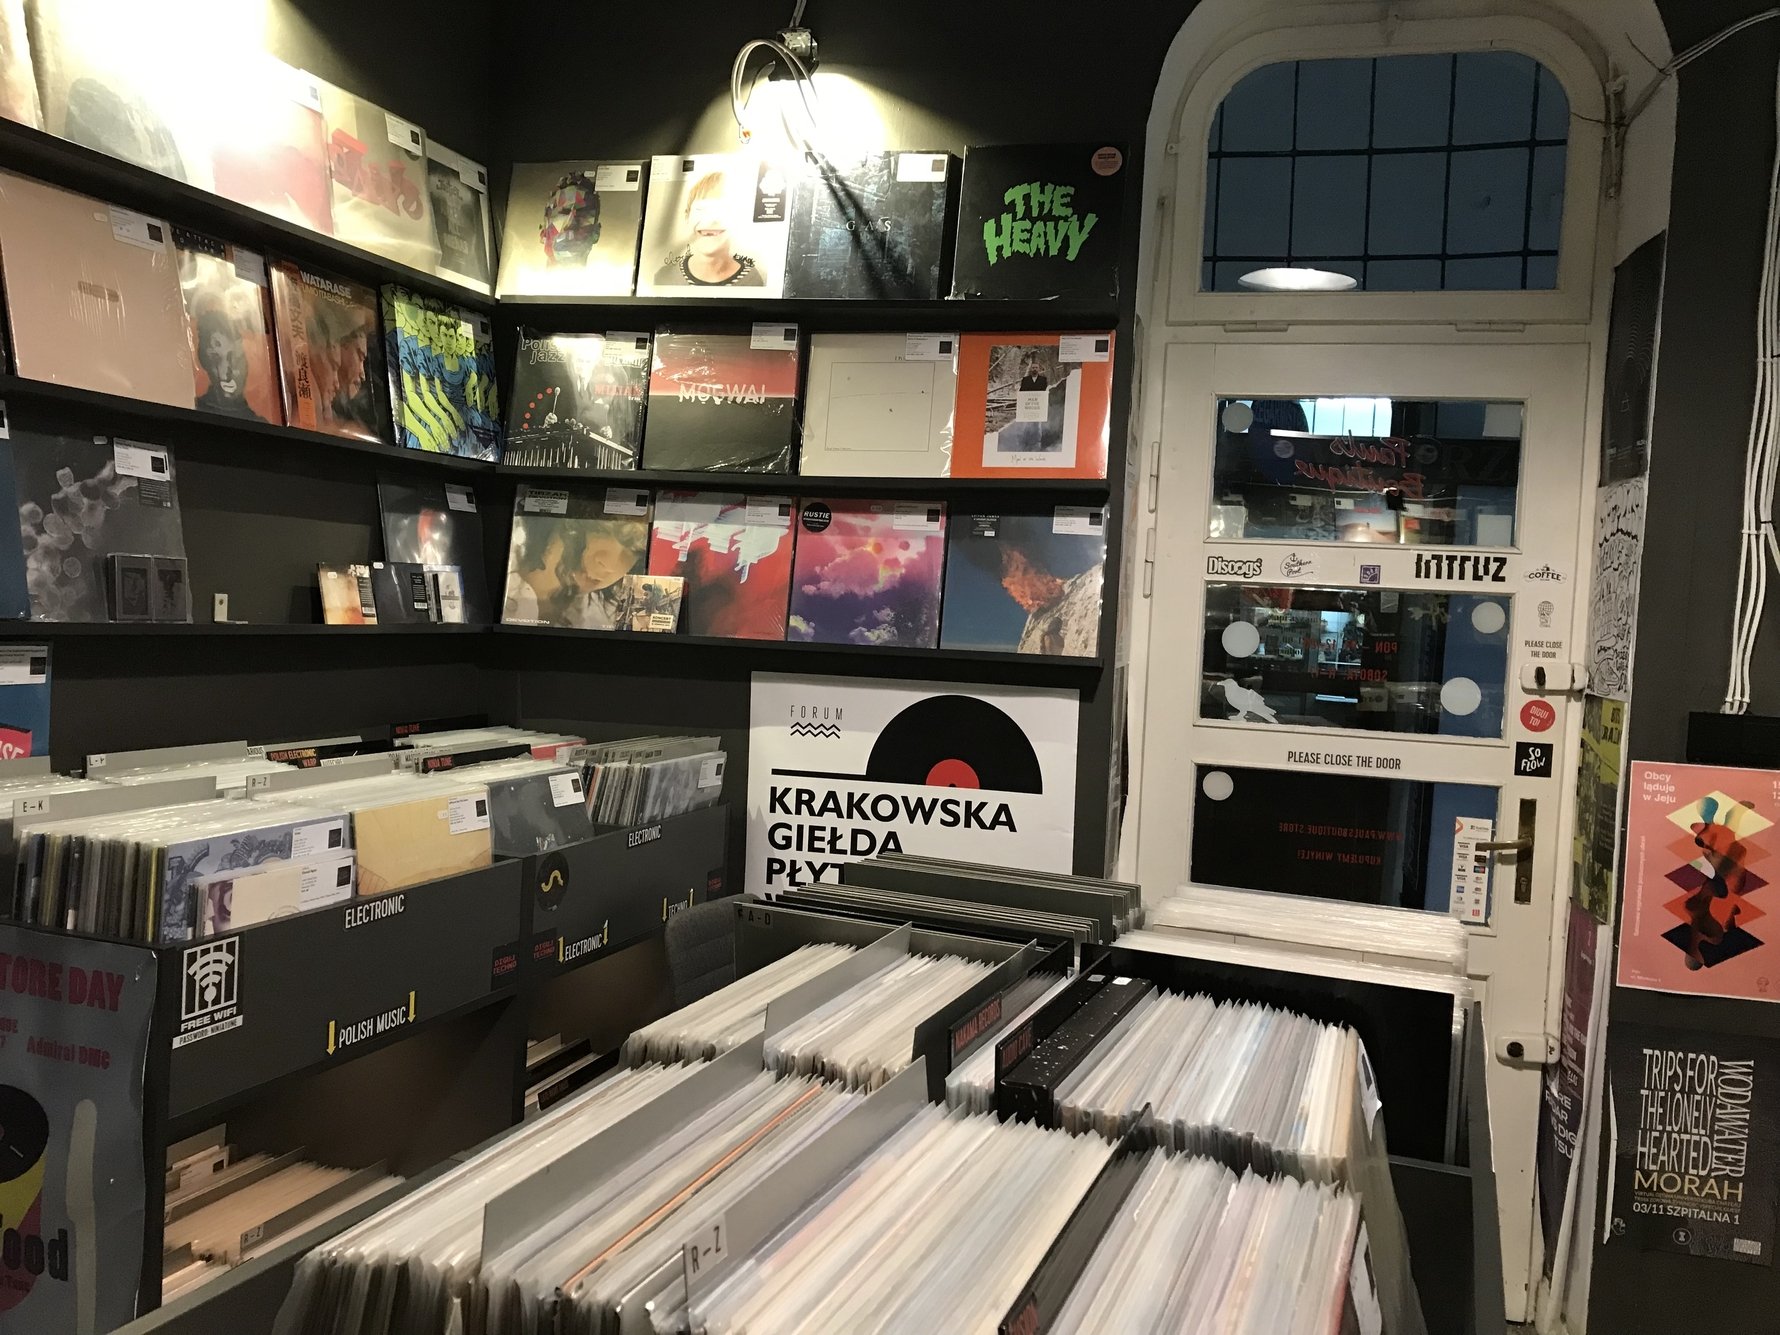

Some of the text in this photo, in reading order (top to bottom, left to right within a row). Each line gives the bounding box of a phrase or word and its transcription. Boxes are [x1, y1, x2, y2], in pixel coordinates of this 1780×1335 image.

[1004, 182, 1075, 219] THE
[983, 213, 1099, 266] HEAVY
[301, 271, 351, 298] WATARASE
[678, 383, 766, 404] MOGWAI
[803, 511, 831, 519] RUSTIE
[1207, 556, 1263, 578] Discogs
[1528, 571, 1562, 582] COFFEE
[1524, 639, 1563, 649] PLEASE CLOSE
[1530, 651, 1540, 659] THE
[790, 705, 843, 721] FORUM
[288, 748, 317, 759] ELECTRONIC
[1287, 750, 1401, 770] PLEASE CLOSE THE DOOR
[1521, 757, 1545, 772] FLOW
[1528, 747, 1541, 760] SO
[1644, 771, 1671, 782] Obcy
[768, 786, 1018, 833] KRAKOWSKA
[1643, 793, 1676, 804] w Jeju
[628, 825, 662, 848] ELECTRONIC
[767, 822, 904, 857] GIEŁDA
[345, 894, 405, 929] ELECTRONIC
[565, 933, 603, 961] ELECTRONIC
[68, 966, 125, 1013] DAY
[181, 1006, 237, 1033] FREE WIFI
[338, 1005, 407, 1049] POLISH MUSIC
[1642, 1048, 1719, 1096] TRIPS FOR
[1640, 1089, 1716, 1136] THE LONELY
[1711, 1060, 1754, 1178] WODAWATER
[1636, 1129, 1713, 1177] HEARTED
[1633, 1169, 1744, 1203] MORAH
[1632, 1202, 1665, 1215] 03/11
[1666, 1205, 1731, 1224] SZPITALNA
[1733, 1214, 1740, 1225] 1
